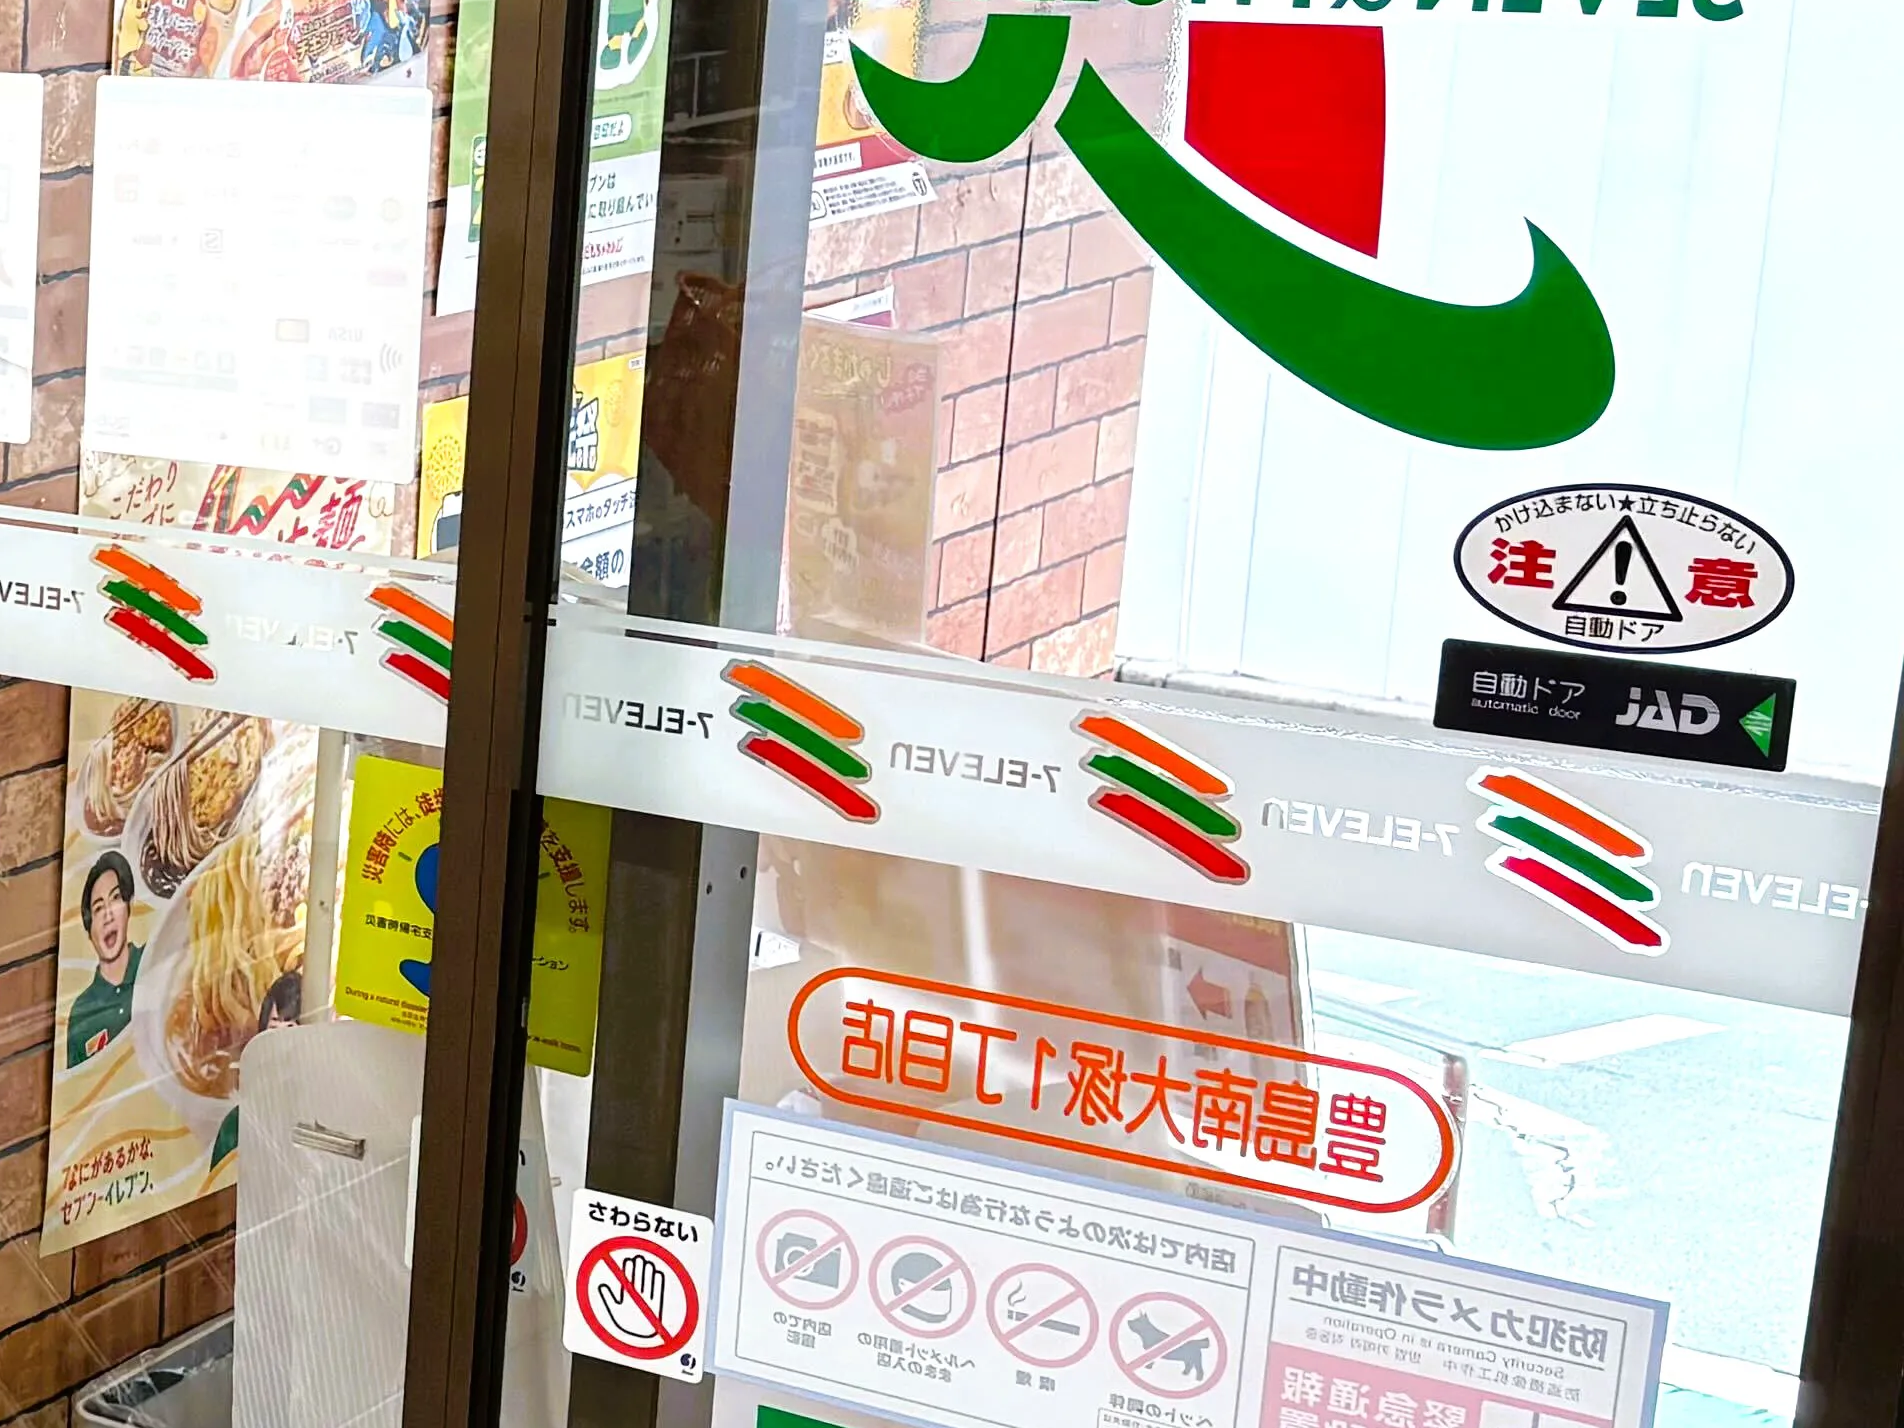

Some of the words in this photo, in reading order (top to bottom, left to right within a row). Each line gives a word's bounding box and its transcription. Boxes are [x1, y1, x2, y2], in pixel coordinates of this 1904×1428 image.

[1487, 538, 1557, 589] 注
[1685, 557, 1758, 610] 意
[1564, 616, 1664, 642] 自動ドア
[1473, 670, 1586, 703] 自動ドア
[1471, 697, 1540, 716] automatic
[1549, 705, 1581, 721] door
[587, 1200, 700, 1243] さわらない
